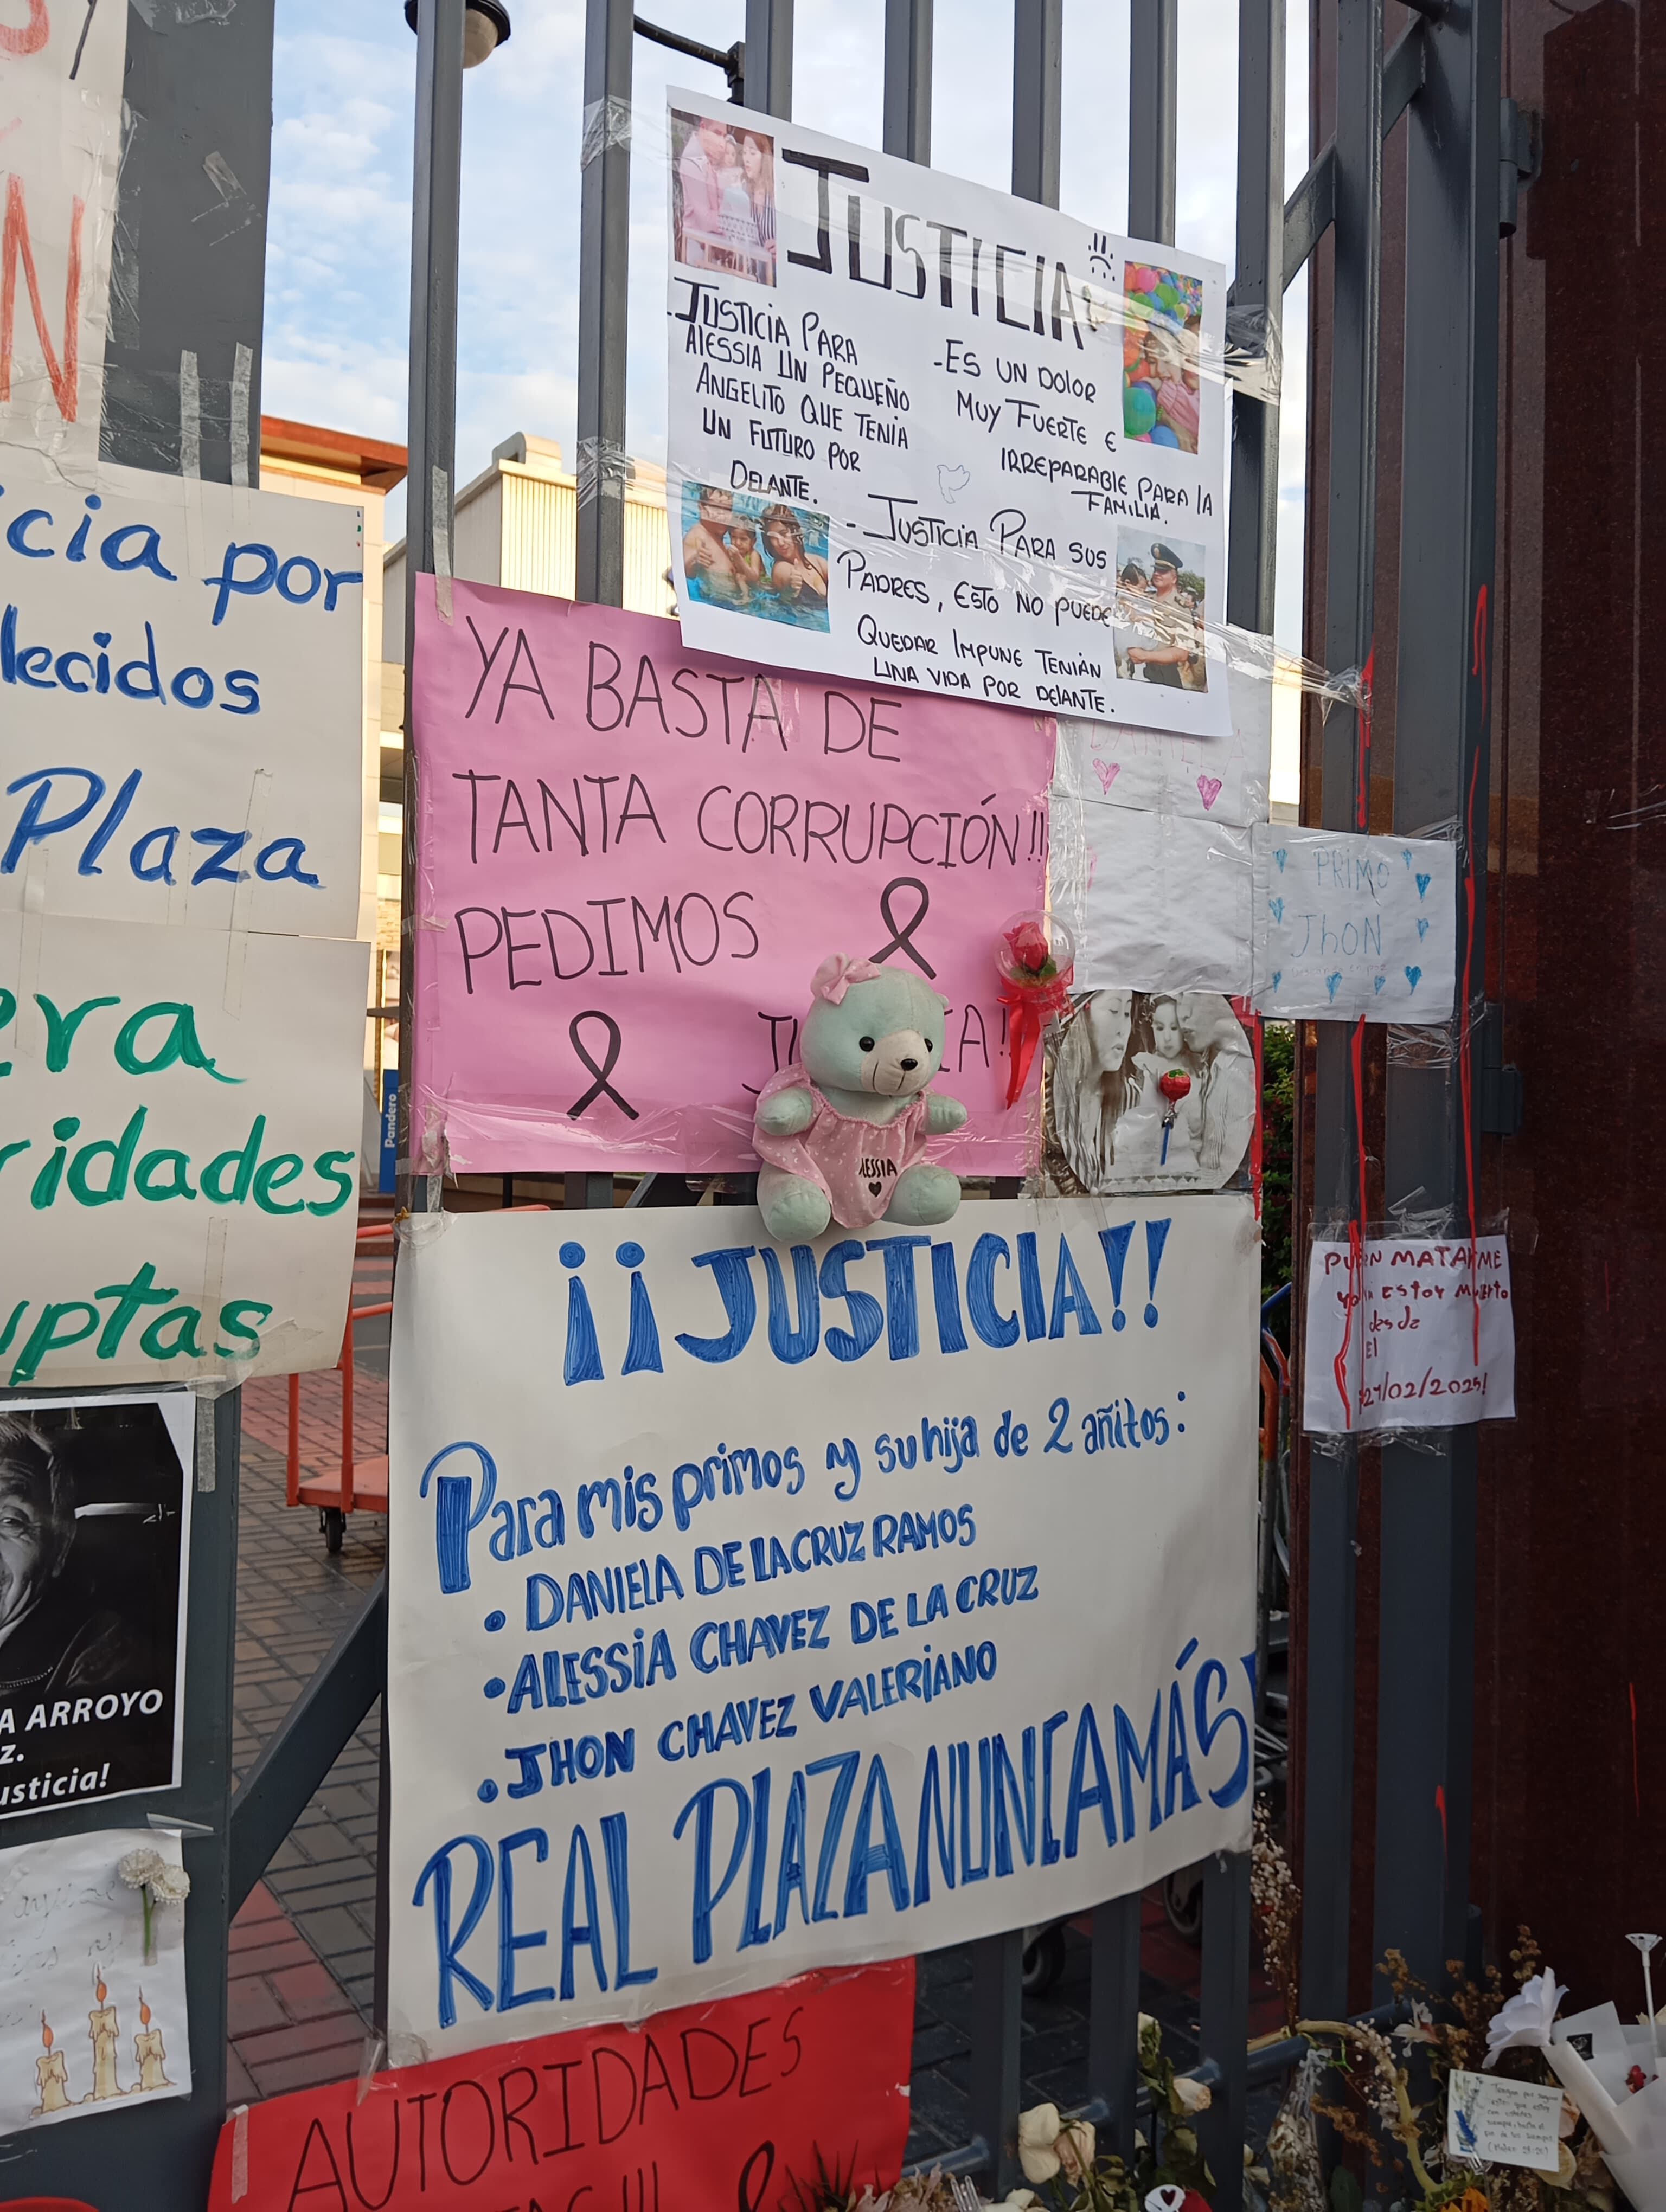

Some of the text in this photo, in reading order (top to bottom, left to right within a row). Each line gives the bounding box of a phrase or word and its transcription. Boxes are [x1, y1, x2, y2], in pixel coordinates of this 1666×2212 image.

[781, 147, 1084, 350] JUSTICIA
[802, 311, 858, 366] PARA
[996, 357, 1027, 383] UN
[778, 350, 807, 382] UN
[823, 362, 910, 412] PEQUEÑO
[800, 394, 843, 432] QUE
[703, 407, 861, 472] UN FUTURO POR
[957, 390, 1001, 433] MUY
[1005, 399, 1087, 445] FUERTE
[1138, 477, 1188, 506] PARA
[0, 484, 363, 626] cia por
[990, 508, 1056, 560] PARA
[1069, 542, 1107, 569] SUS
[954, 581, 999, 613] ESTO
[1017, 592, 1043, 616] NO
[857, 614, 938, 656] QUEDAR
[953, 628, 1023, 667] IMPUNE
[465, 615, 902, 762] YA BASTA DE
[927, 667, 971, 689] VIDA
[983, 675, 1021, 699] POR
[0, 767, 326, 889] Plaza
[452, 769, 1044, 869] TANTA CORRUPCIÓN!!
[454, 891, 758, 994] PEDIMOS
[385, 1094, 397, 1148] Pandero
[420, 1441, 565, 1593] Para
[578, 1465, 663, 1538] mis
[673, 1442, 805, 1531] primos
[994, 1410, 1028, 1458] de
[1043, 1397, 1073, 1454] 2
[526, 1554, 684, 1631] DANIELA
[694, 1541, 745, 1596] DE
[873, 1504, 976, 1557] RAMOS
[690, 1605, 830, 1674] CHAVEZ
[850, 1598, 899, 1644] DE
[907, 1583, 949, 1627] LA
[956, 1565, 1039, 1613] CRUZ
[24, 1689, 163, 1731] ARROYO
[505, 1728, 635, 1799] JHON
[658, 1693, 797, 1761] CHAVEZ
[412, 1811, 658, 2029] REAL
[672, 1750, 911, 1965] PLAZA
[913, 1702, 1118, 1908] NUNCA
[287, 2007, 803, 2212] AUTORIDADES
